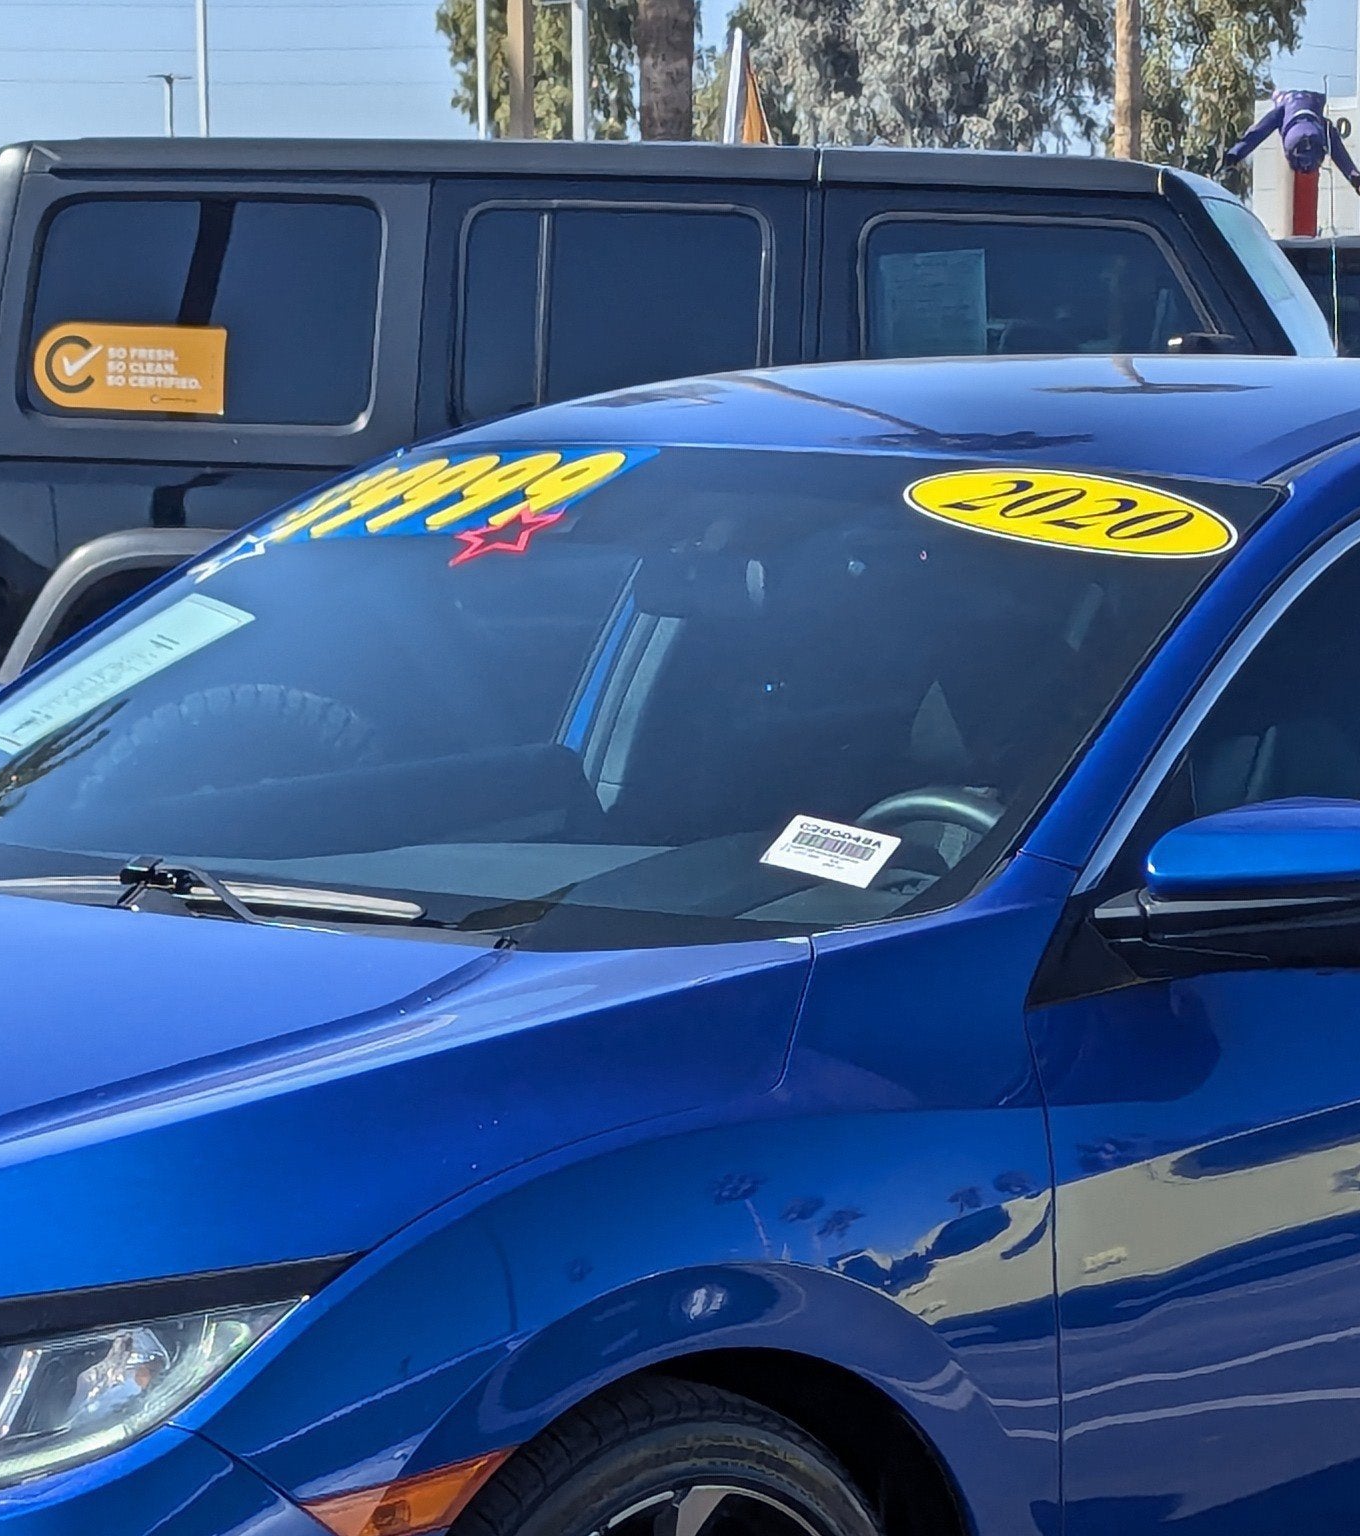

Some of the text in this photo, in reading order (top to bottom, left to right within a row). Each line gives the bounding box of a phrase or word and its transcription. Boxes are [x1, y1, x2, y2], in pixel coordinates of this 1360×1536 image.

[107, 347, 179, 361] SO FRESH.
[107, 361, 178, 375] SO CLEAN.
[106, 375, 202, 390] SO CERTIFIED.
[939, 480, 1195, 539] 2020
